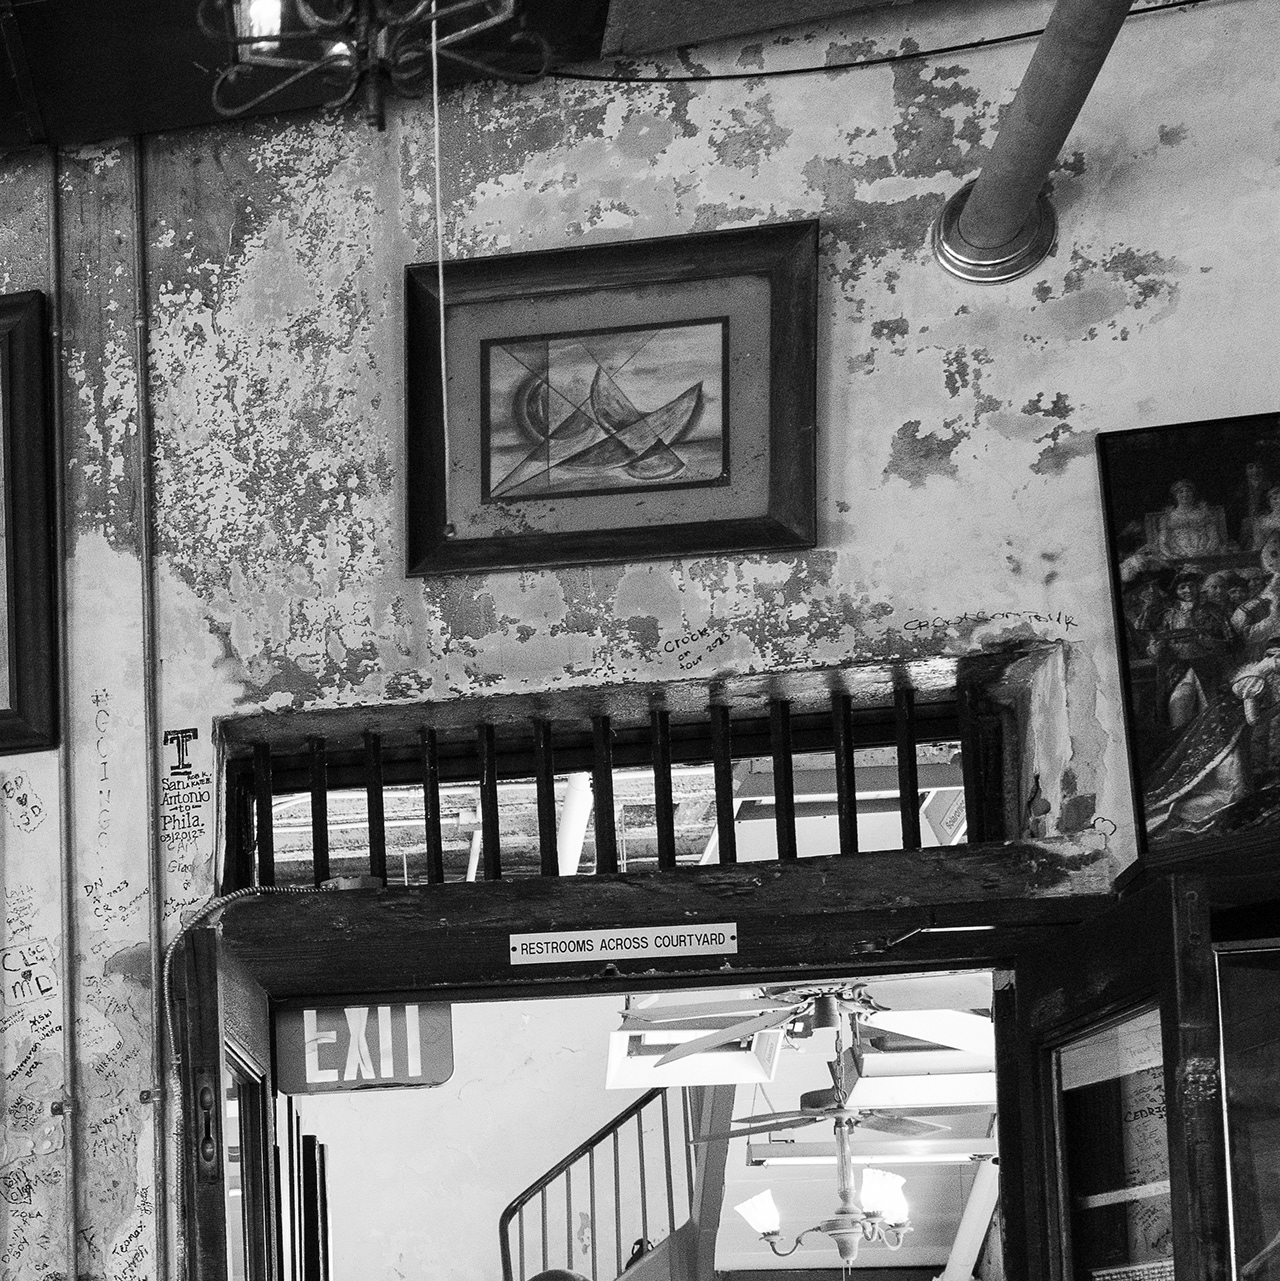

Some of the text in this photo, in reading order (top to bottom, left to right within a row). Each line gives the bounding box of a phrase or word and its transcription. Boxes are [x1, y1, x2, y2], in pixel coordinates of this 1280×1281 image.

[162, 778, 184, 791] San
[160, 787, 210, 806] Antonio
[160, 813, 205, 831] Phila.
[521, 932, 726, 955] RESTROOMS ACROSS COURTYARD
[304, 1005, 422, 1083] EXIT
